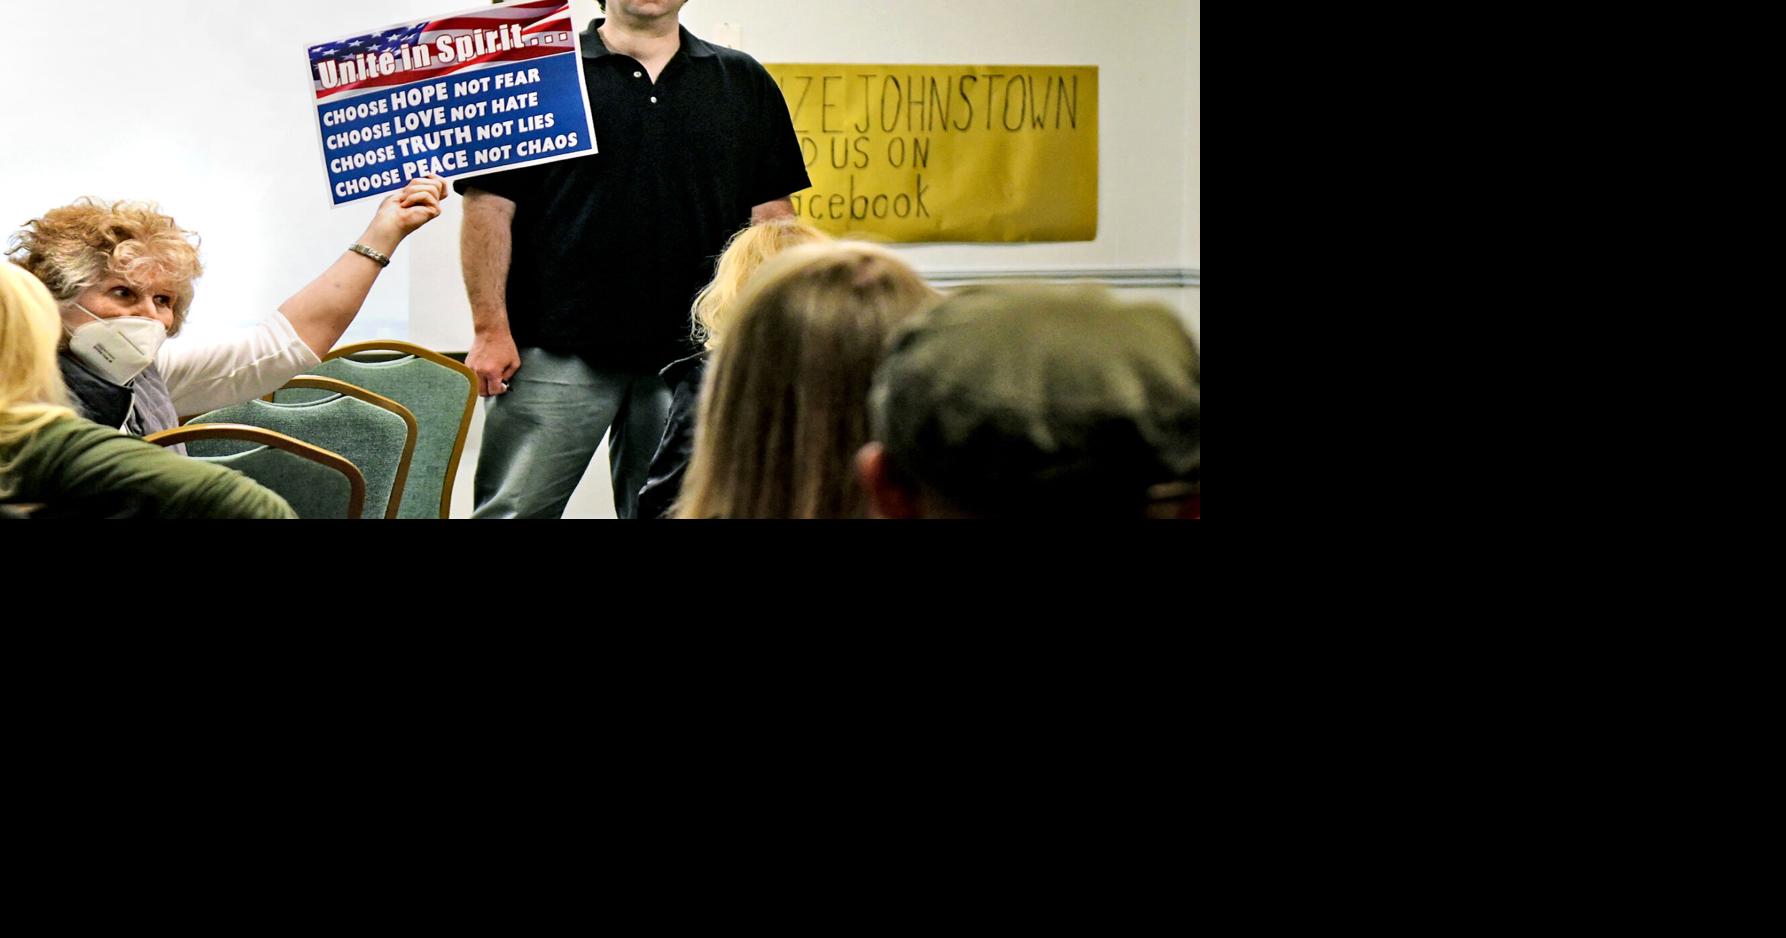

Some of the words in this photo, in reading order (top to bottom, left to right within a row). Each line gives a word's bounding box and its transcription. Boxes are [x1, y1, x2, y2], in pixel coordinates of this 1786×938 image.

[317, 51, 397, 89] Unite
[400, 41, 431, 72] in
[323, 99, 388, 127] CHOOSE
[391, 82, 448, 111] HOPE
[454, 76, 491, 98] NOT
[495, 68, 541, 89] FEAR
[326, 122, 392, 150] CHOOSE
[394, 108, 447, 135] LOVE
[450, 101, 487, 122] NOT
[491, 92, 539, 114] HATE
[854, 74, 1079, 134] JOHNSTOWN
[330, 146, 396, 174] CHOOSE
[397, 126, 472, 157] TRUTH
[477, 120, 514, 141] NOT
[518, 113, 555, 134] LIES
[335, 170, 401, 198] CHOOSE
[403, 150, 468, 180] PEACE
[474, 145, 512, 165] NOT
[517, 132, 578, 156] CHAOS
[830, 136, 870, 169] US
[887, 136, 930, 169] ON
[790, 173, 931, 220] acebook
